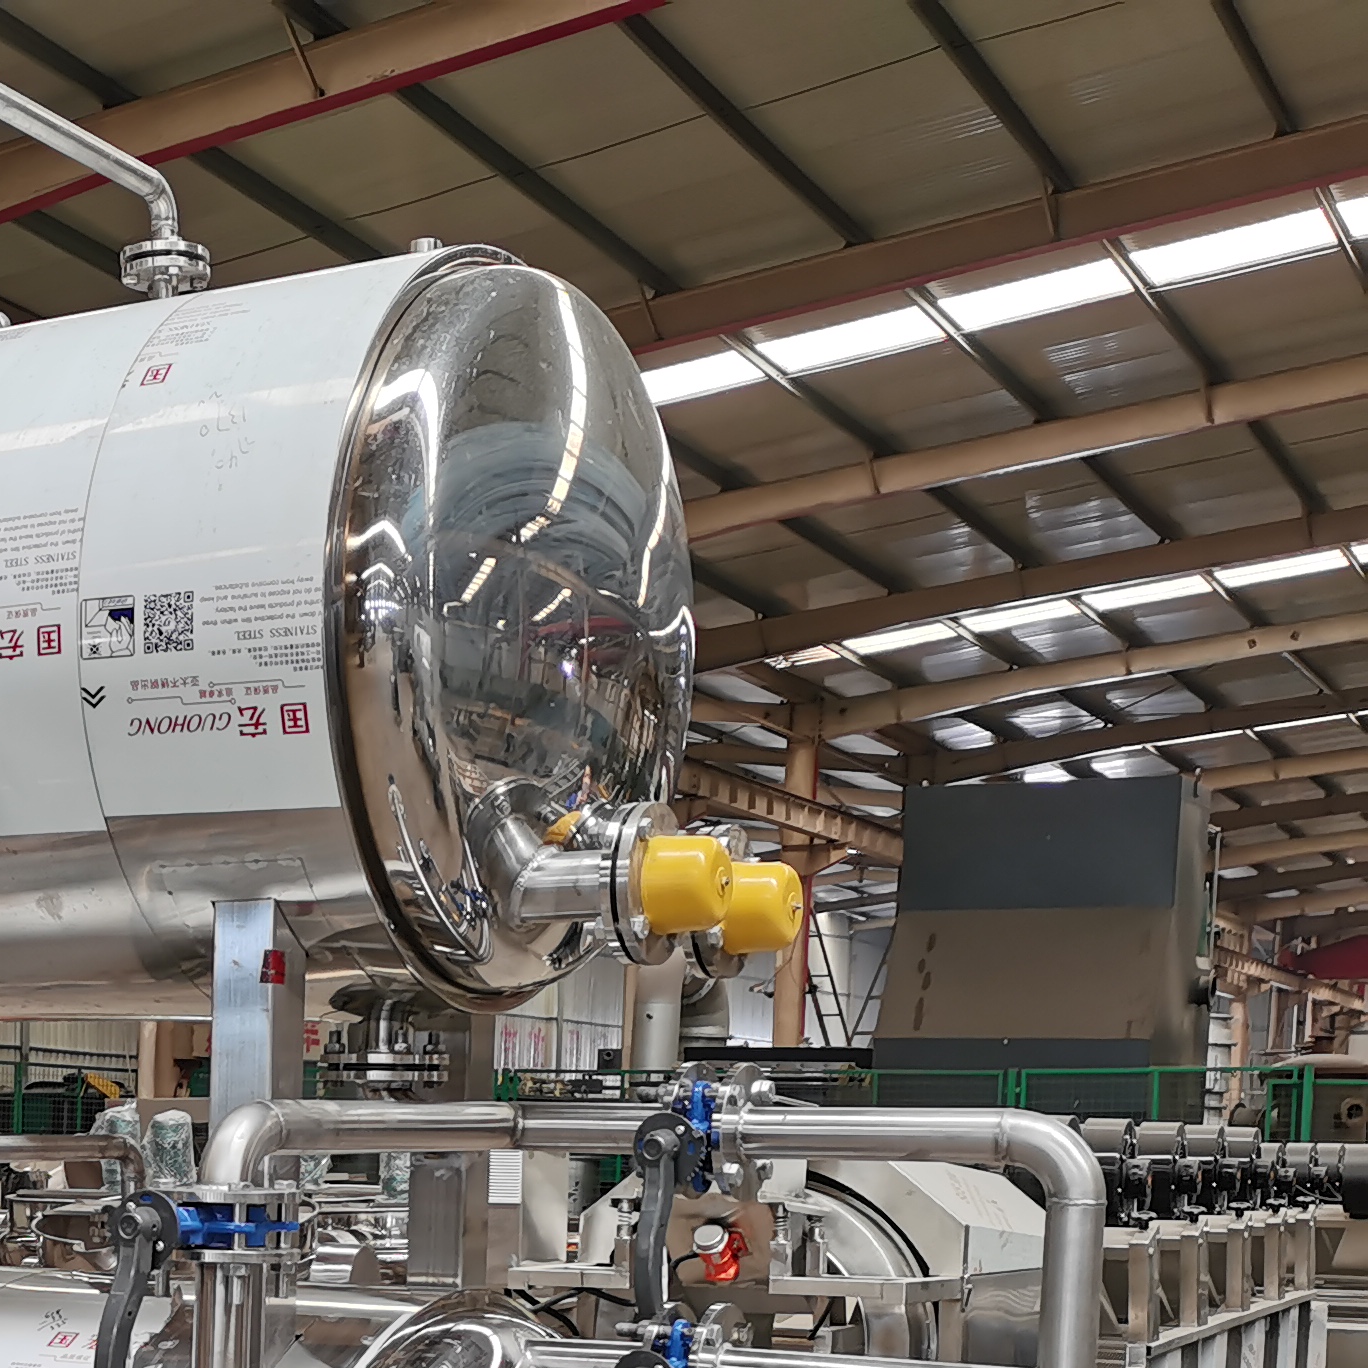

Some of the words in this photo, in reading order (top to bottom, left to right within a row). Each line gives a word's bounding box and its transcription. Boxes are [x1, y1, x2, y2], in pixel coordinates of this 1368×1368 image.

[4, 556, 29, 568] STEEL
[234, 630, 263, 640] STEEL
[128, 711, 232, 737] GUOHONG
[237, 703, 309, 737] 国宏
